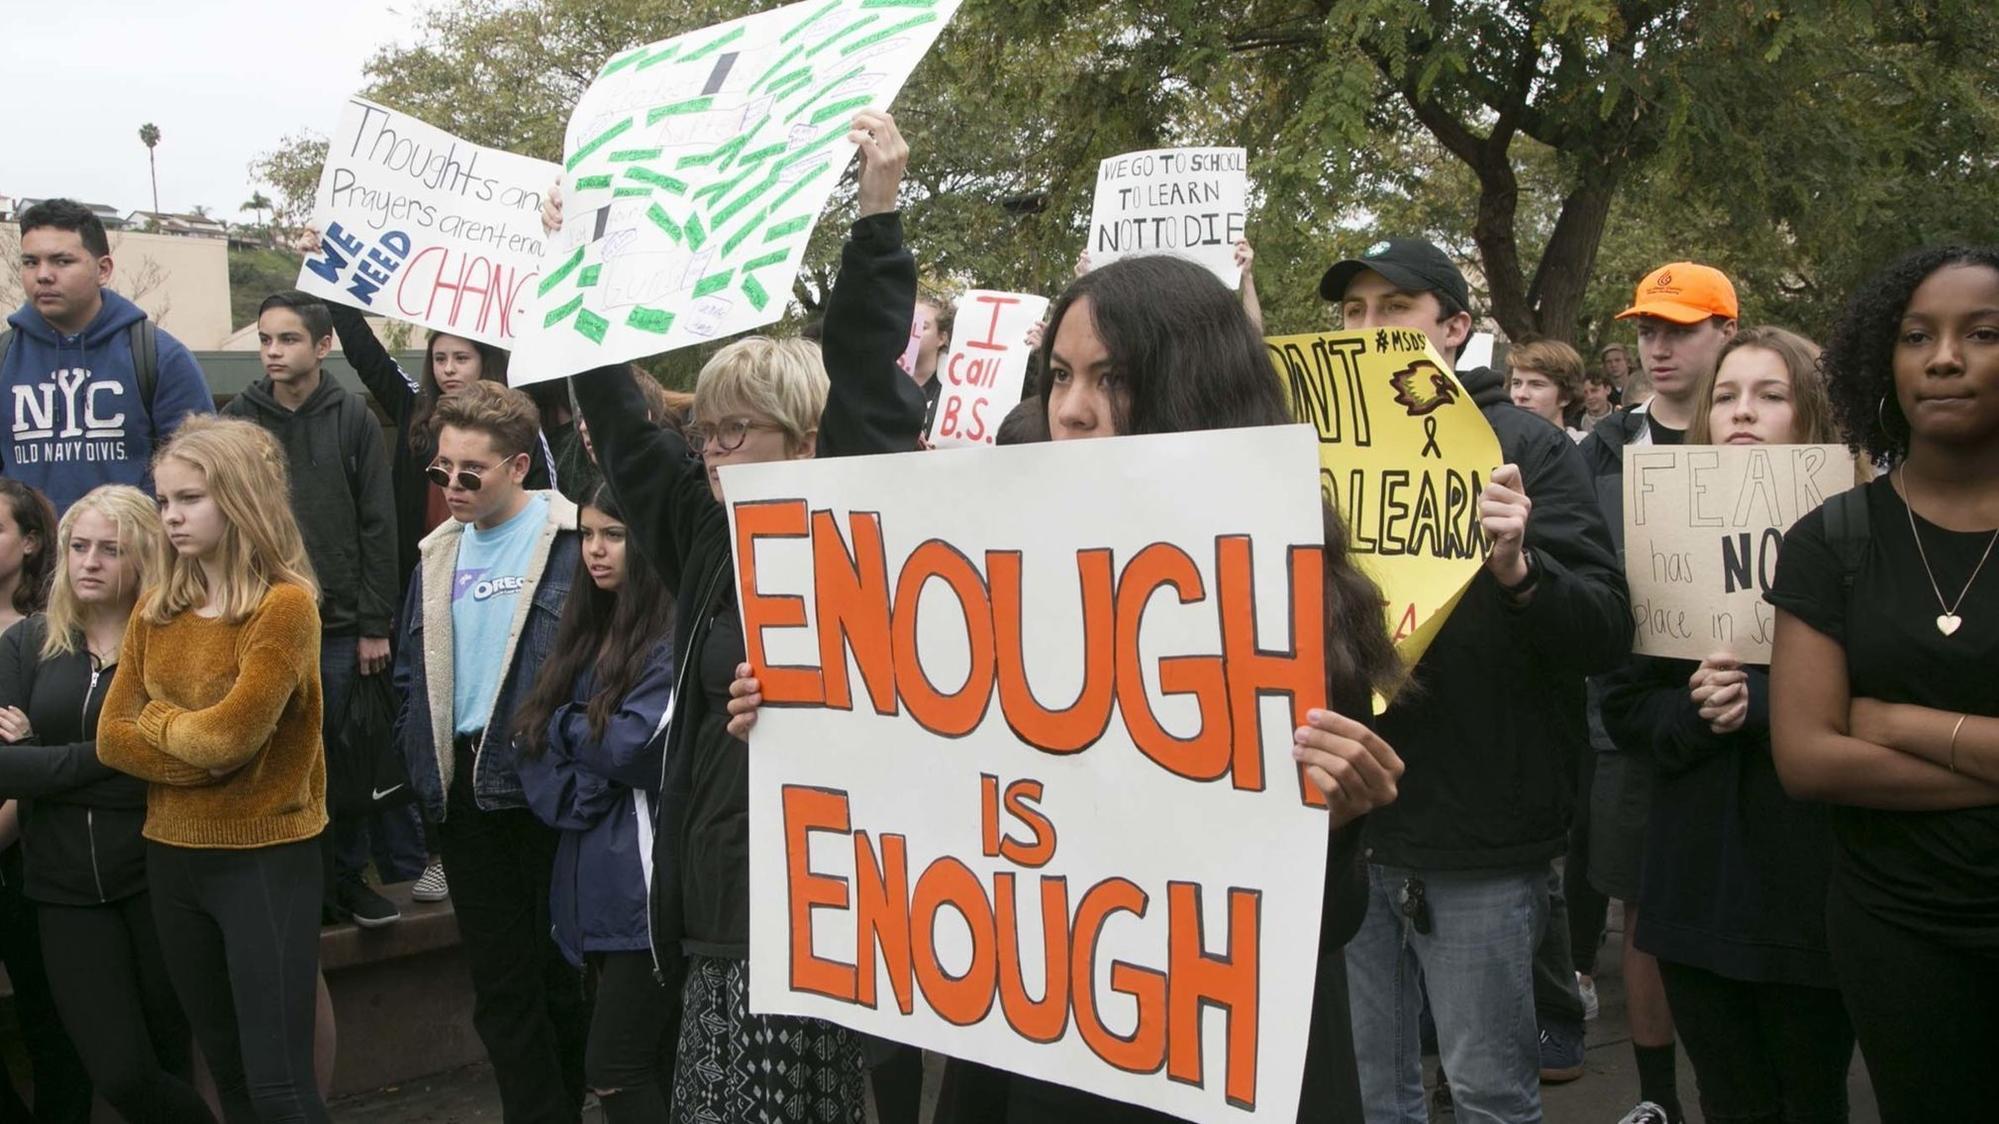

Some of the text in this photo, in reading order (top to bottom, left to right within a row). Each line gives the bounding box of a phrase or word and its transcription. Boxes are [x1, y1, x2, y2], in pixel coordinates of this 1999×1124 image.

[350, 100, 499, 201] Thoughts
[500, 187, 544, 213] an
[1104, 152, 1245, 181] WE GO TO SCHOOL
[331, 168, 438, 229] Prayers
[1118, 181, 1220, 210] TO LEARN
[305, 221, 366, 284] WE
[1099, 212, 1243, 252] NOT TO DIE
[346, 230, 412, 306] NEED
[966, 296, 1020, 351] I
[12, 367, 125, 438] NYC
[940, 395, 993, 444] B.S.
[14, 441, 128, 465] OLD NAVY DIVIS.
[1633, 447, 1826, 528] FEAR
[1650, 527, 1783, 594] has NO
[733, 498, 1330, 809] ENOUGH
[1634, 599, 1692, 646] place
[1710, 605, 1733, 643] in
[980, 773, 1057, 868] IS
[782, 784, 1262, 1112] ENOUGH
